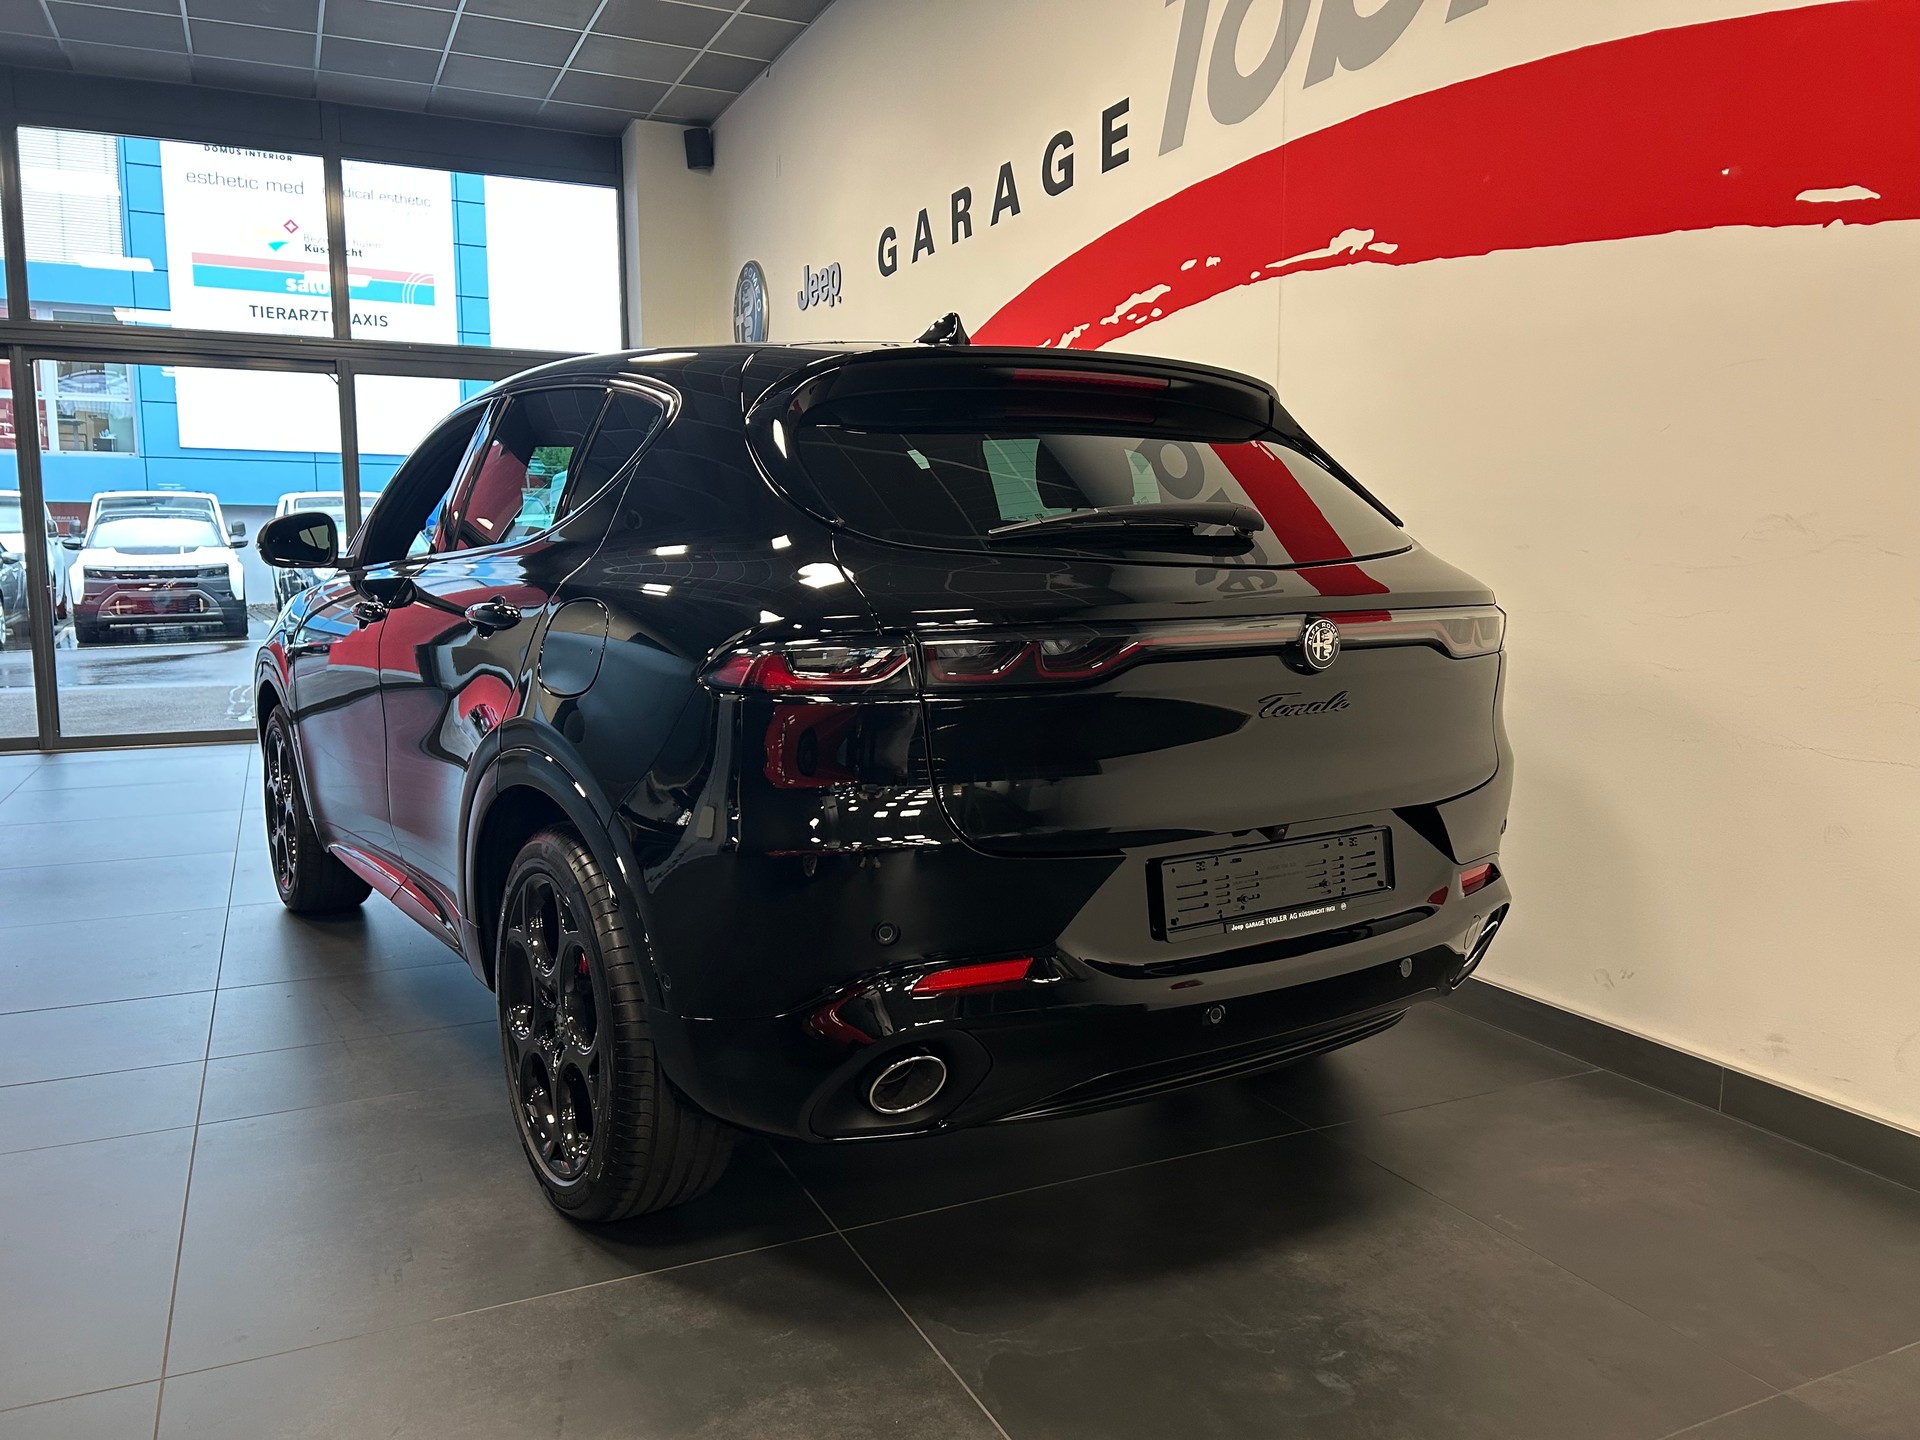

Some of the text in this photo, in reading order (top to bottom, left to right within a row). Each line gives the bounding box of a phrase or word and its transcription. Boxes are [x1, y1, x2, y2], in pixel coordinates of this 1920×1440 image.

[203, 144, 294, 162] DOMUS INTERIOR
[185, 170, 259, 190] esthetic
[266, 180, 304, 195] med
[378, 192, 432, 208] esthetic
[877, 97, 1131, 278] GARAGE
[797, 261, 842, 311] Jeep
[248, 304, 389, 328] TIERARZTAXIS
[1307, 622, 1339, 646] ALFA ROMEO
[1231, 923, 1244, 931] Jeep
[1245, 919, 1265, 930] GARAGE
[1265, 914, 1287, 925] TOBLER
[1289, 911, 1298, 920] AG
